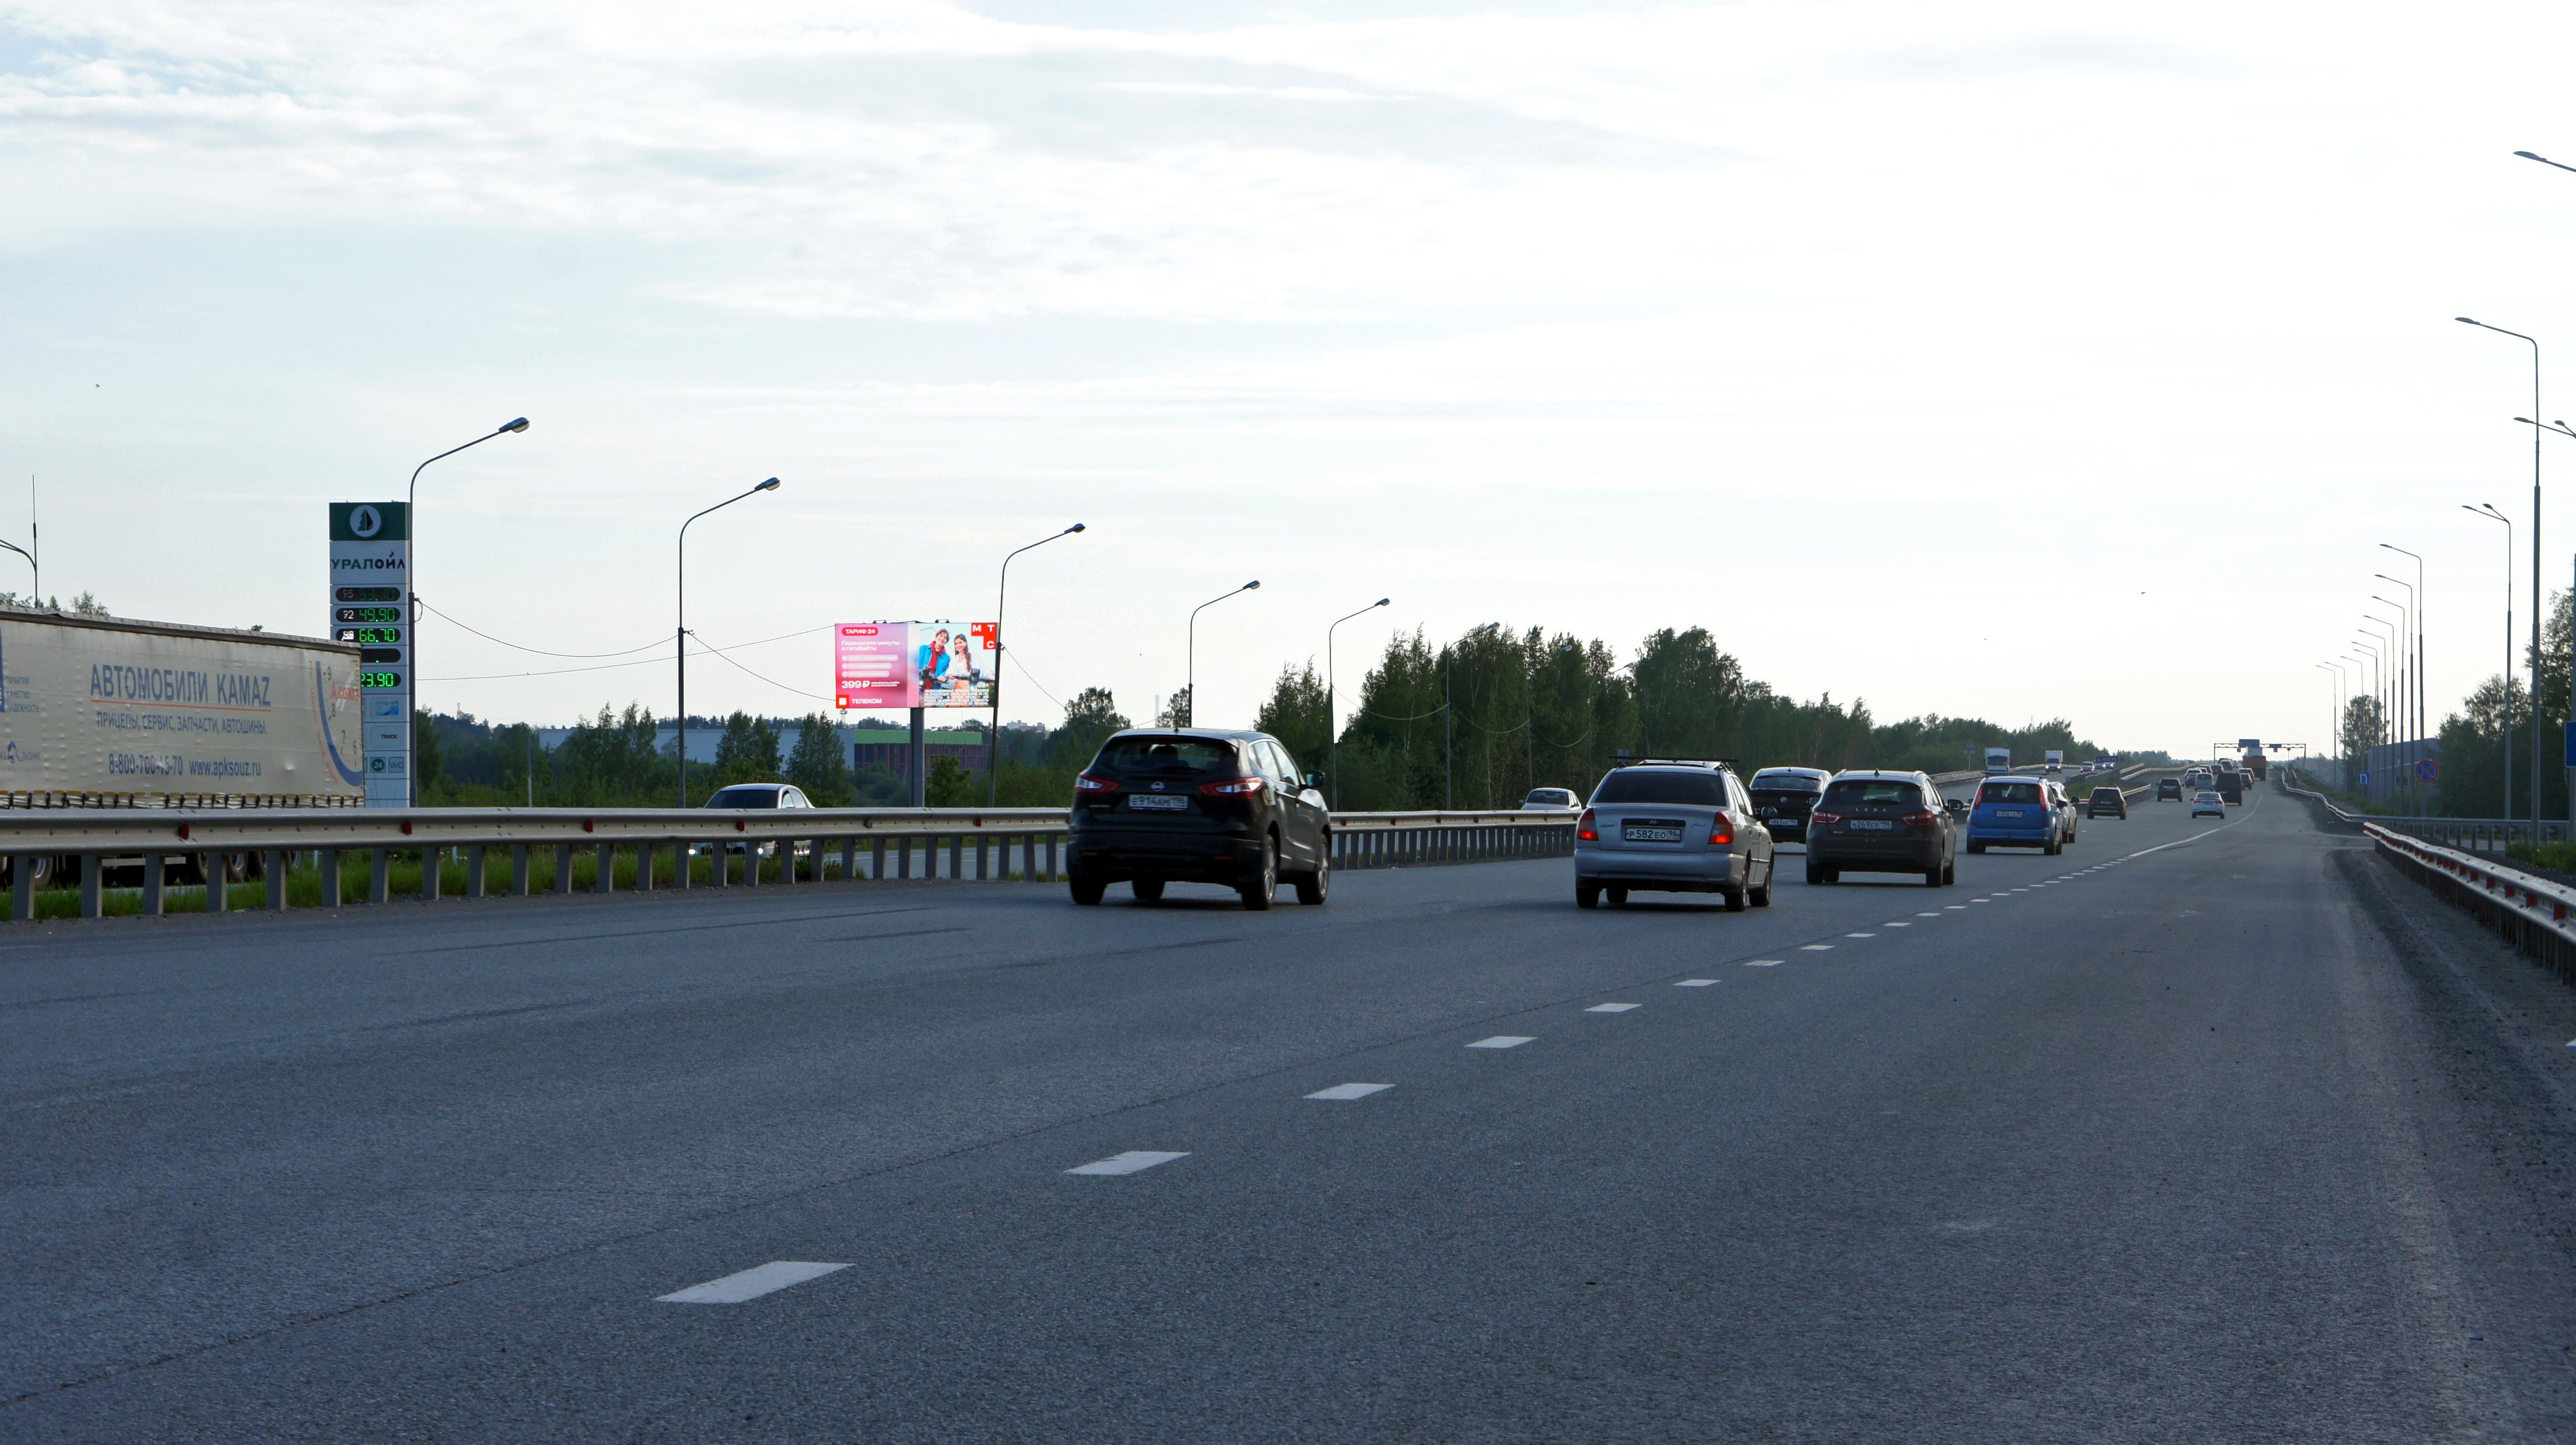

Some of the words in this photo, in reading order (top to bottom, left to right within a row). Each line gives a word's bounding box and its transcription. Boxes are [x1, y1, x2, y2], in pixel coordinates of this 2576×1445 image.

[331, 553, 405, 569] УРАЛОЙЛ
[343, 590, 353, 598] 95
[343, 610, 354, 619] 92
[359, 608, 395, 622] 49.90
[359, 628, 395, 643] 66.70
[6, 675, 29, 685] ГАРАНТИЯ
[91, 664, 208, 703] АВТОМОБИЛИ
[217, 673, 271, 707] KAMAZ
[7, 690, 30, 699] КАЧЕСТВО
[8, 703, 39, 713] НАДЕЖНОСТЬ
[97, 711, 140, 731] ПРИЦЕПЫ,
[142, 714, 176, 733] СЕРВИС,
[177, 716, 220, 735] ЗАПЧАСТИ,
[222, 718, 267, 734] АВТОШИНЫ.
[189, 757, 261, 780] www.apksouz.ru
